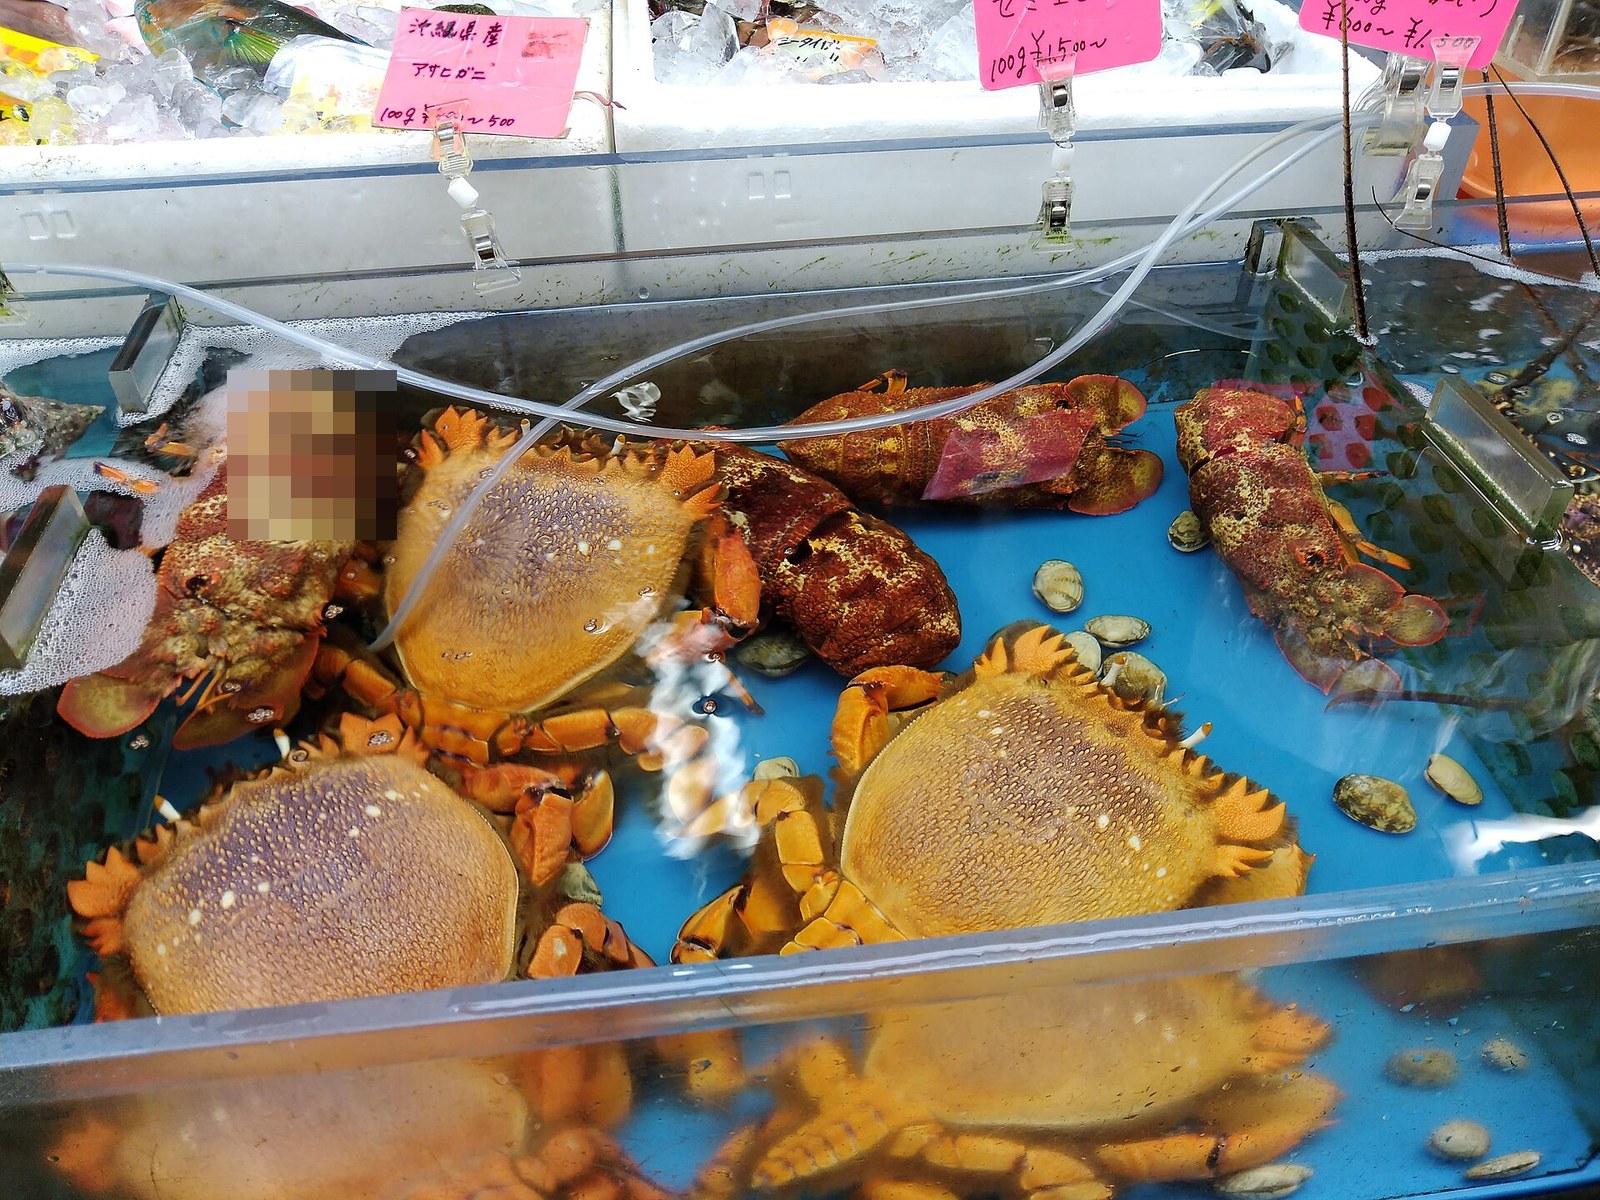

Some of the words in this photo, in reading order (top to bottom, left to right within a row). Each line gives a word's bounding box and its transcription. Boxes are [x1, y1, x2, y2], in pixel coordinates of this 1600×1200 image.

[411, 62, 486, 80] アサヒガニ
[380, 107, 416, 126] 100g
